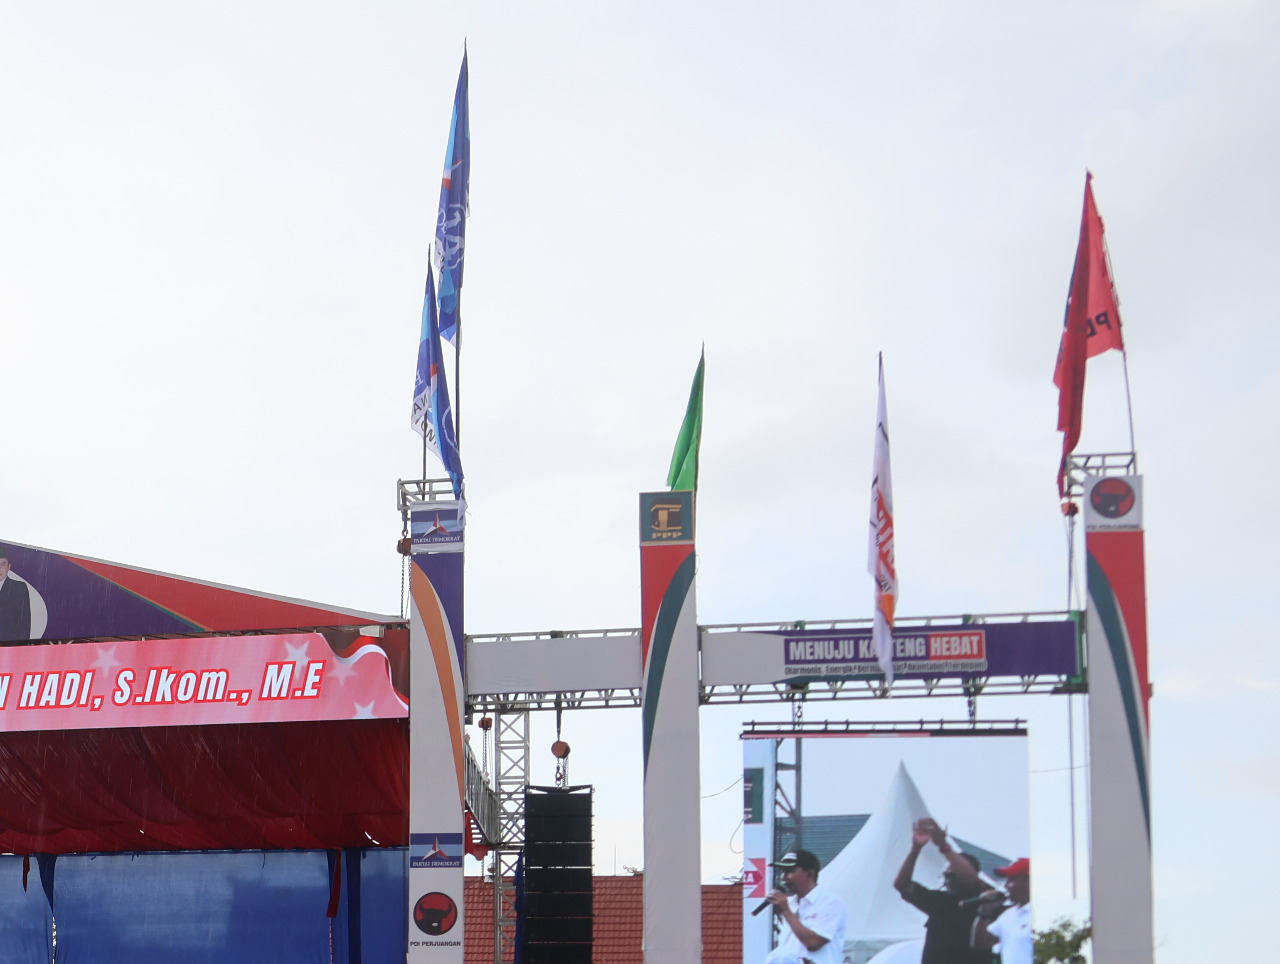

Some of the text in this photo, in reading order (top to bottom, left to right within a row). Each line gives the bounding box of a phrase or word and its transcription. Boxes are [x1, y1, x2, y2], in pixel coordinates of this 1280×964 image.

[789, 635, 980, 661] MENUJU KATENG HEBAT
[17, 667, 104, 711] HADI,
[260, 660, 326, 701] M.E
